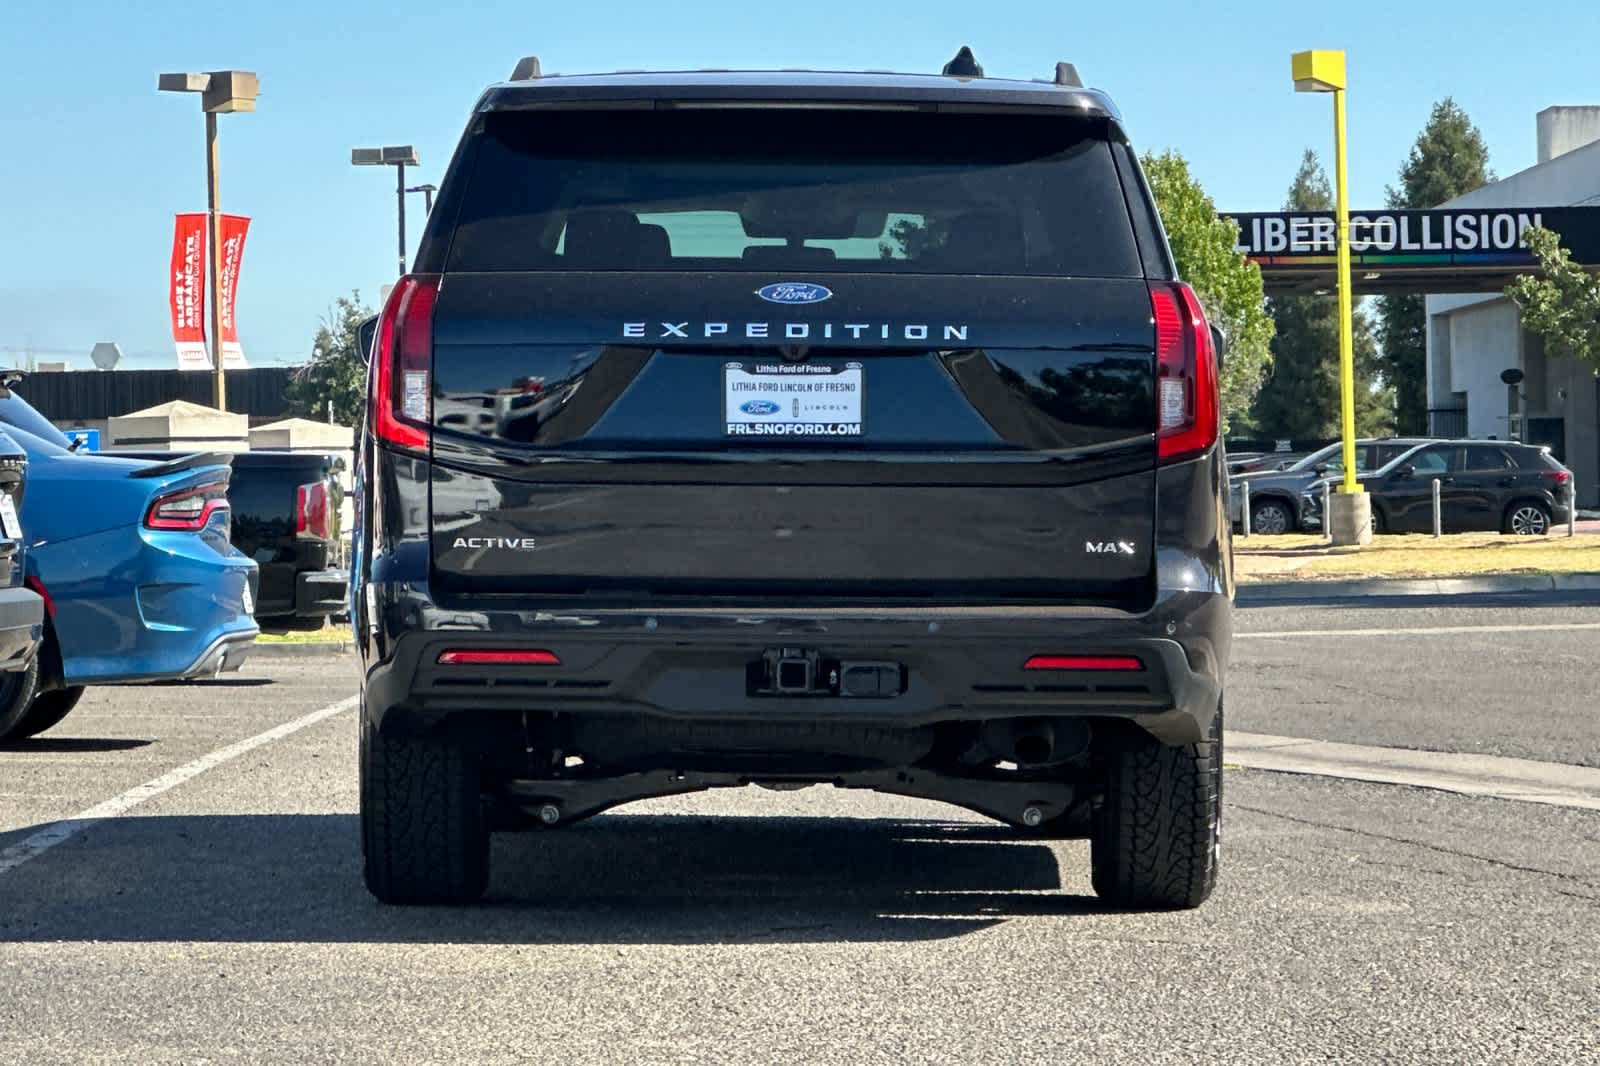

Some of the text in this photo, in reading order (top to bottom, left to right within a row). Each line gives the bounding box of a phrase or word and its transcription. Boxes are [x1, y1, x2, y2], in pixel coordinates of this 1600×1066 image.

[1349, 213, 1543, 251] COLLISION
[772, 286, 817, 300] Ford
[623, 321, 968, 340] EXPEDITION
[756, 365, 832, 373] Lithia Ford of Fresno
[732, 382, 856, 392] LITHIA FORD LINCOLN OF FRESNO
[453, 537, 536, 549] ACTIVE
[1085, 541, 1135, 554] MAX
